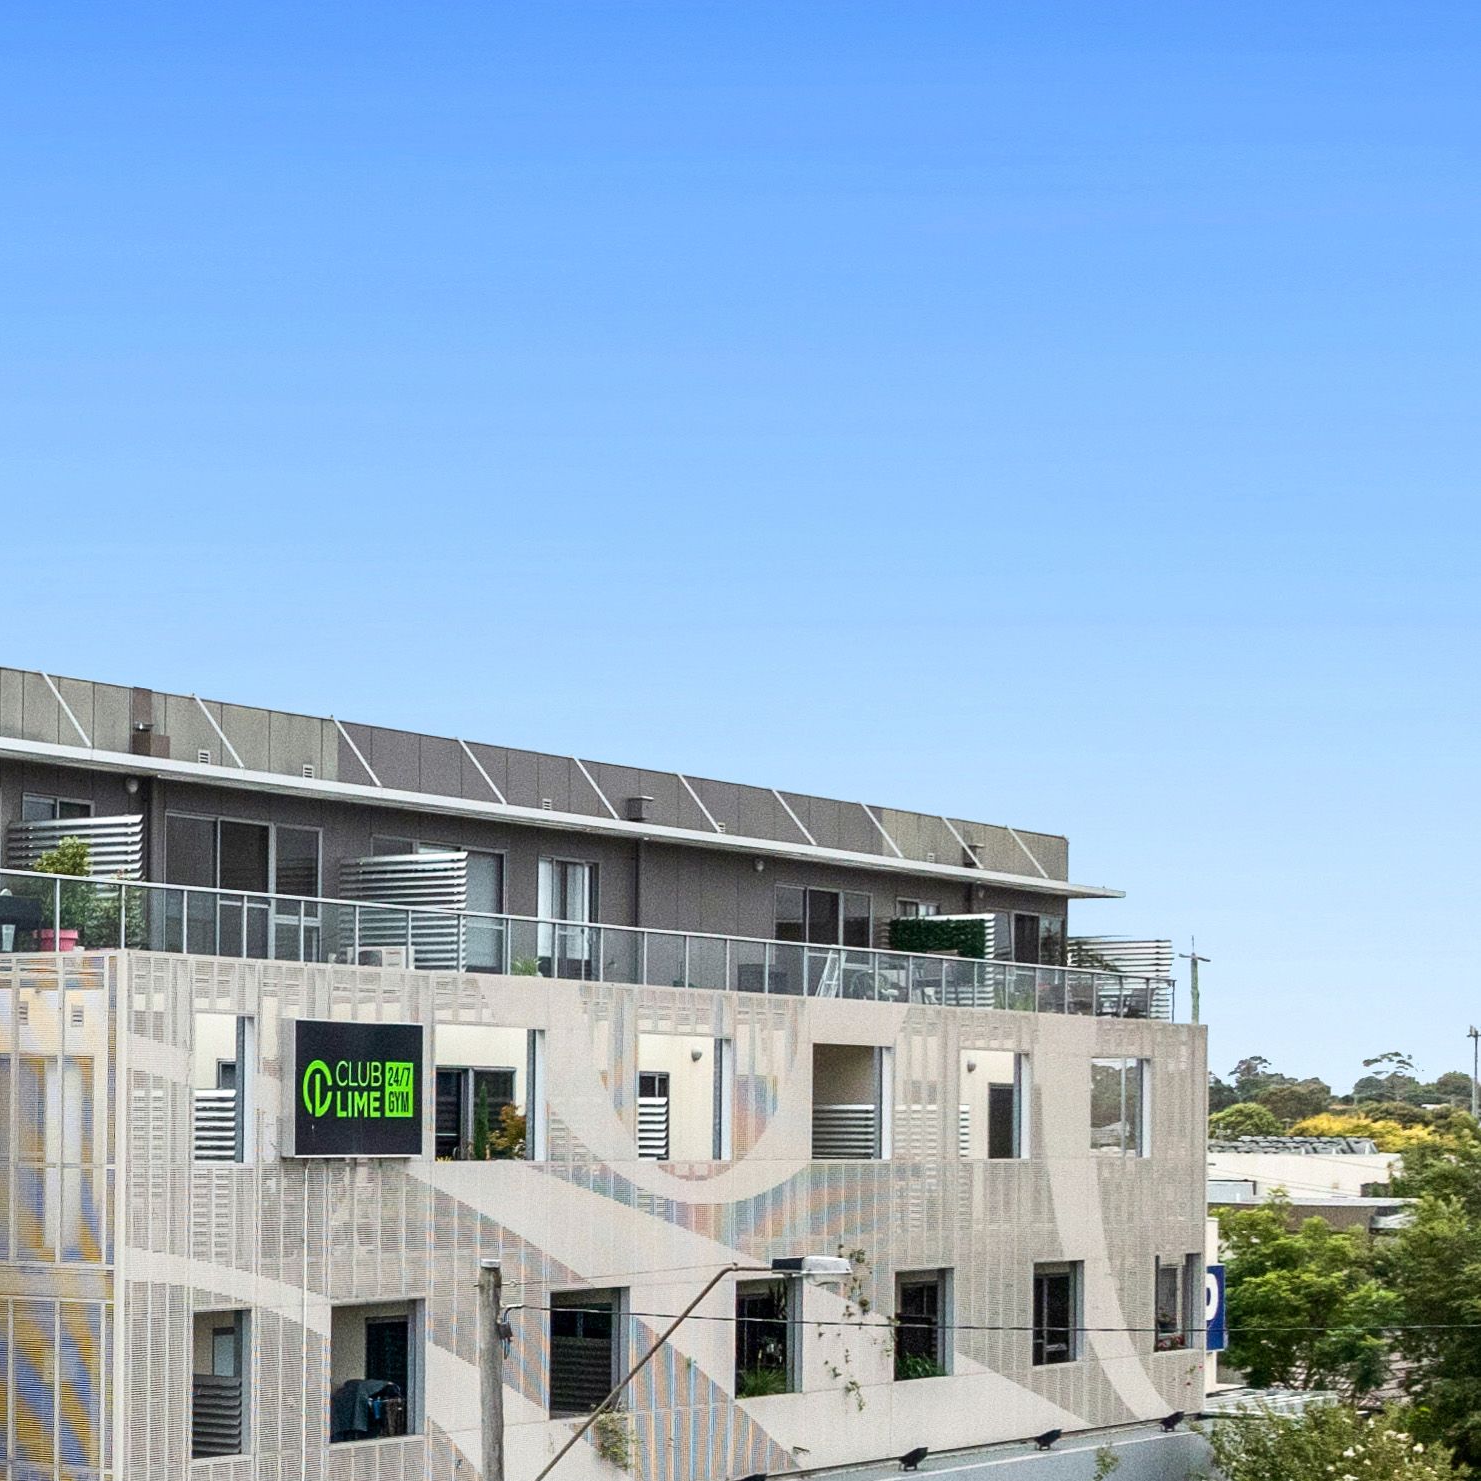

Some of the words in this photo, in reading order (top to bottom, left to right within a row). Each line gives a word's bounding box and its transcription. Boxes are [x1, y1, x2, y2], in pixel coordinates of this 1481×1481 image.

[336, 1060, 382, 1087] CLUB
[387, 1066, 411, 1087] 24/7
[336, 1091, 381, 1118] LIME
[388, 1091, 409, 1113] GYM
